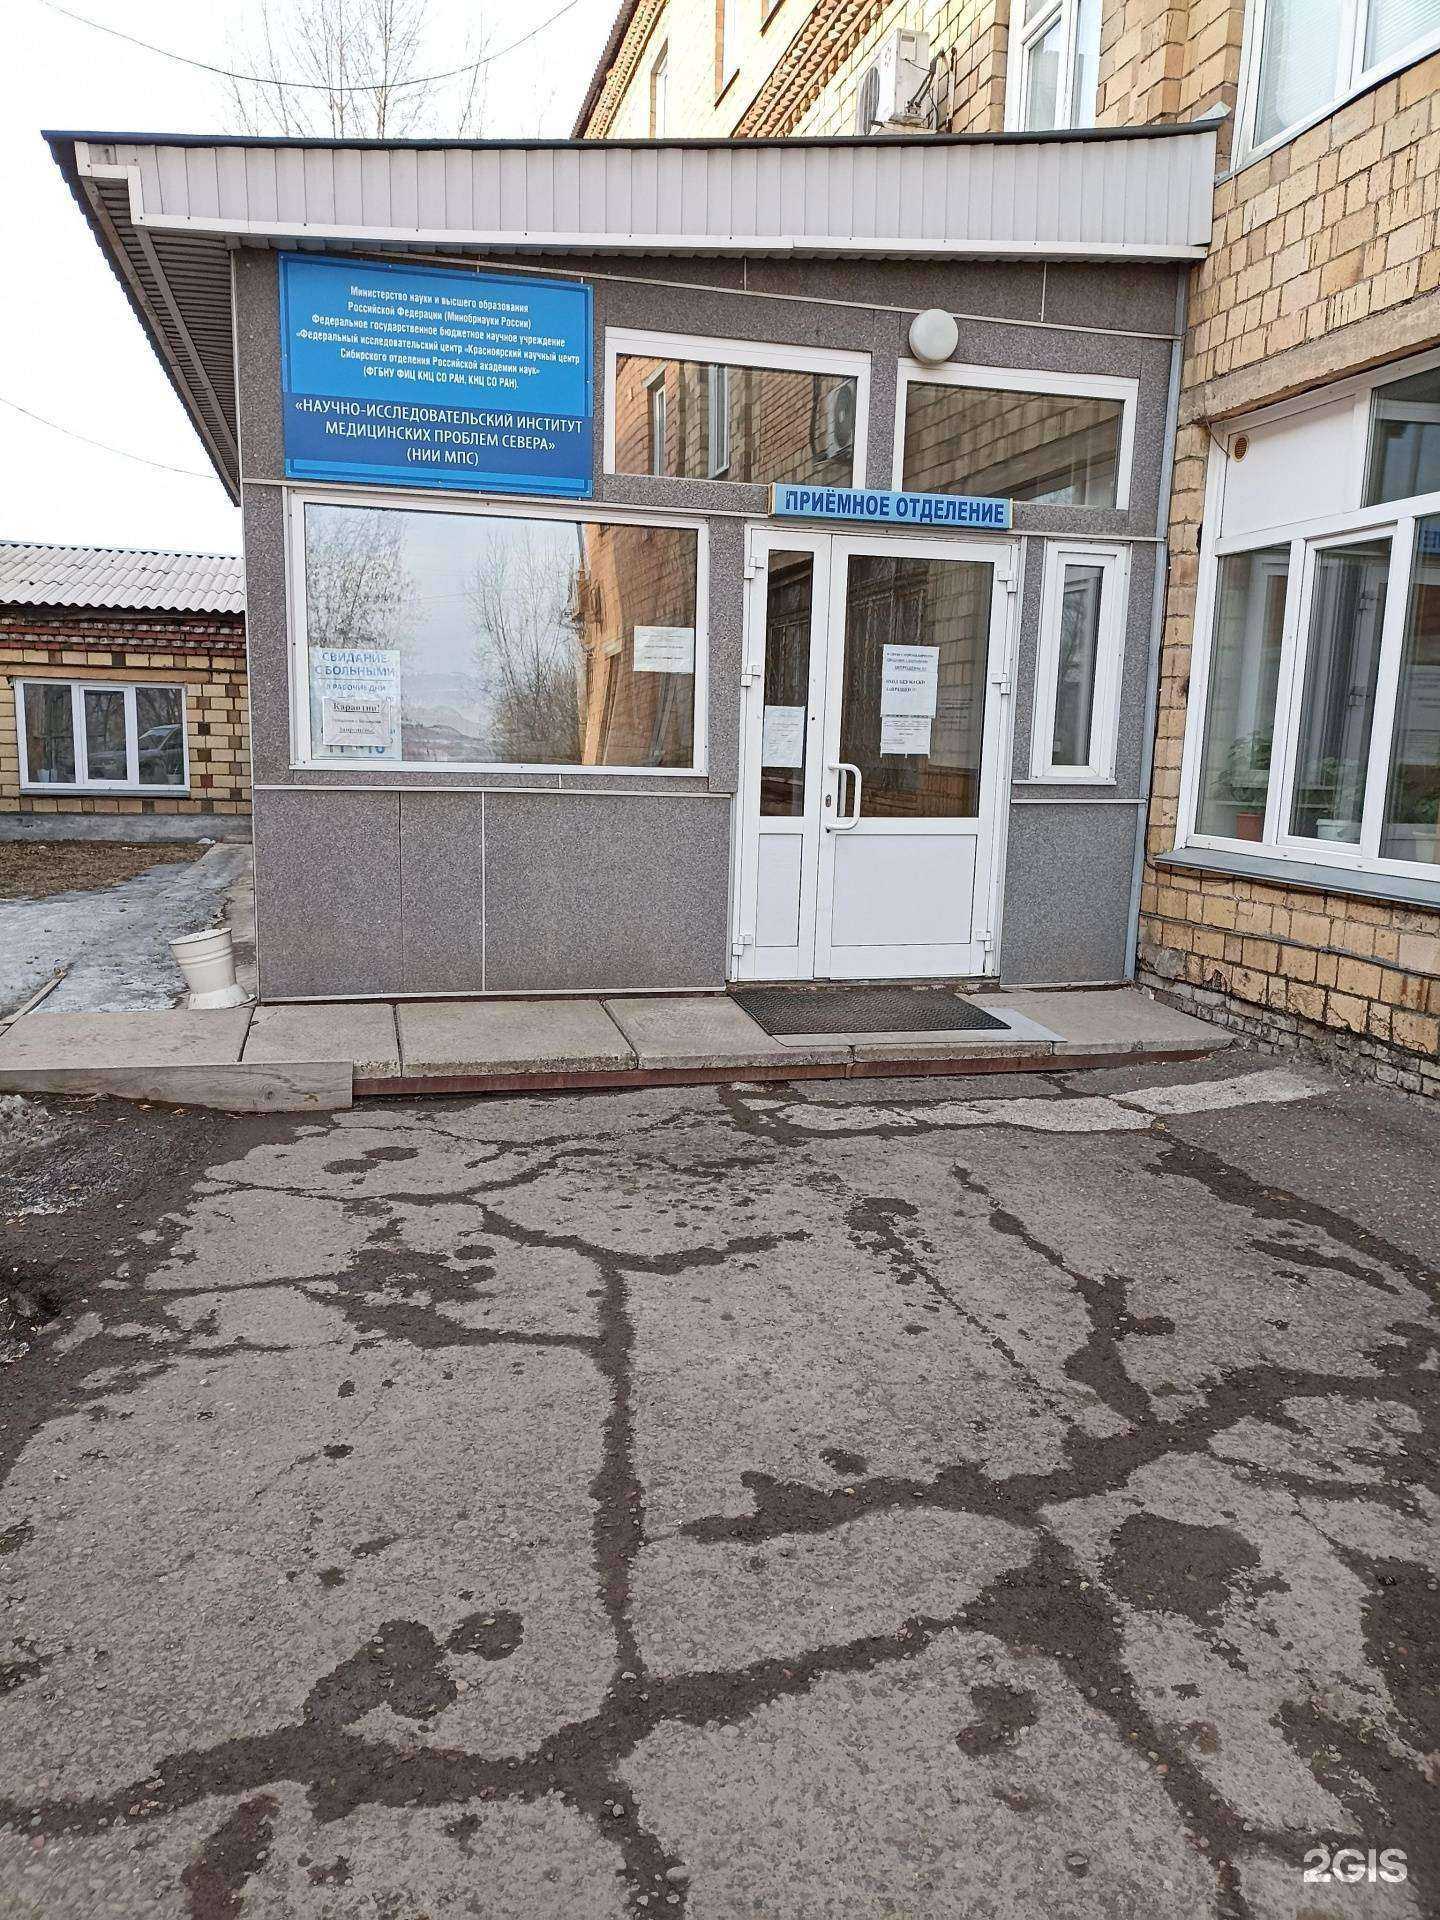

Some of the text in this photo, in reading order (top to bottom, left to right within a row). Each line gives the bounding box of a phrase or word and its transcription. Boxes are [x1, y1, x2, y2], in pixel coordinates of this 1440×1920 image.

[350, 286, 408, 301] Министерство
[410, 295, 433, 305] науки
[441, 297, 477, 307] высшего
[478, 299, 529, 313] образования
[311, 313, 566, 347] Федеральное государственное бюджетное научное учреждение
[347, 301, 532, 330] Российской Федерации (Минобрнауки России)
[296, 328, 580, 366] «Федеральный исследовательский центр «Красноярский научный центр
[340, 347, 541, 376] Сибирского отделения Российской академии наук»
[363, 366, 394, 378] (ФГБНУ
[396, 368, 416, 381] ФИЦ
[417, 371, 435, 383] КНЦ
[436, 372, 447, 382] СО
[468, 375, 486, 387] КНЦ
[486, 376, 497, 387] СО
[295, 398, 583, 434] «НАУЧНО-ИССЛЕДОВАТЕЛЬСКИЙ ИНСТИТУТ
[325, 421, 555, 451] МЕДИЦИНСКИХ ПРОБЛЕМ СЕВЕРА»
[407, 447, 479, 466] (НИИ МПС)
[785, 489, 1005, 523] ПРИЁМНОЕ ОТДЕЛЕНИЕ
[322, 652, 388, 664] СВИДАНИЕ
[325, 665, 396, 677] БОЛЬНЫМИ
